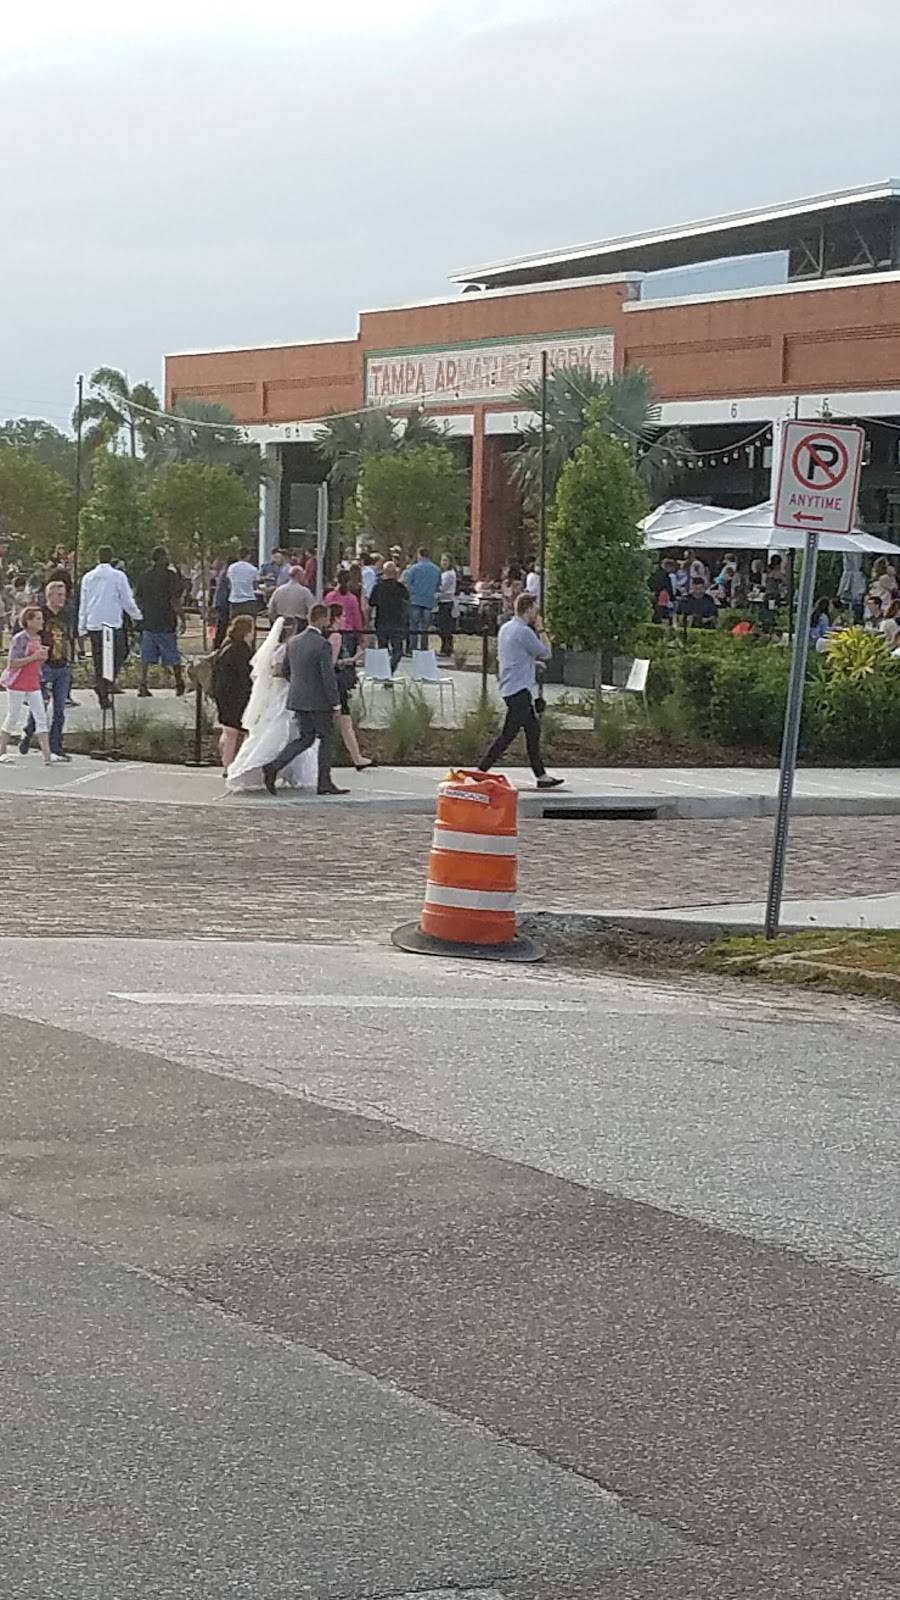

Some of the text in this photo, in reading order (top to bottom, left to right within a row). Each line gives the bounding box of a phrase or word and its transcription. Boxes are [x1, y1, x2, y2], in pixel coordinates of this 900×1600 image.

[370, 360, 426, 396] TAMPA
[730, 402, 738, 419] 6
[807, 443, 839, 480] P
[789, 493, 842, 510] ANYTIME
